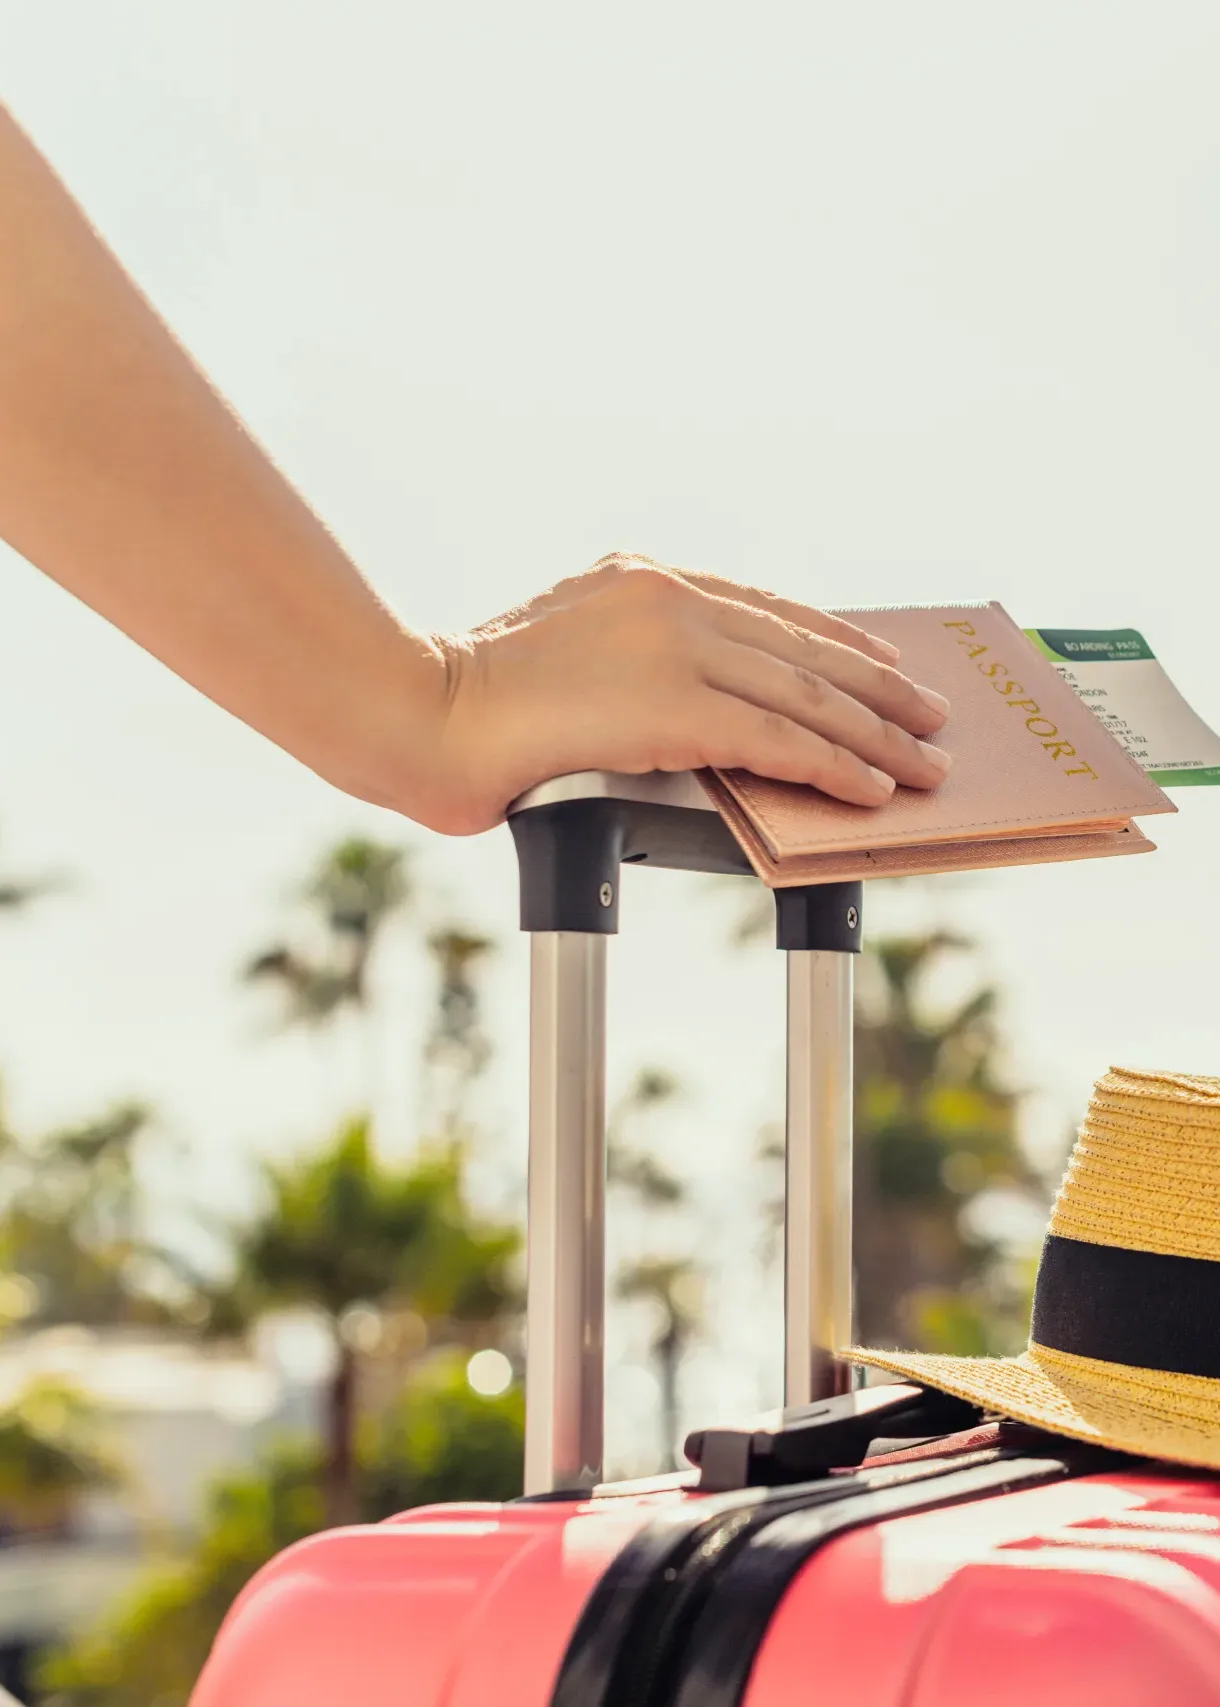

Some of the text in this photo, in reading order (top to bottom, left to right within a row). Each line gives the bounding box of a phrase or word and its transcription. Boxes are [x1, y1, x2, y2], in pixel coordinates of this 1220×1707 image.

[1064, 640, 1141, 652] BOARDING PASS
[1072, 689, 1108, 697] ONDON
[942, 620, 1100, 781] PASSPORT
